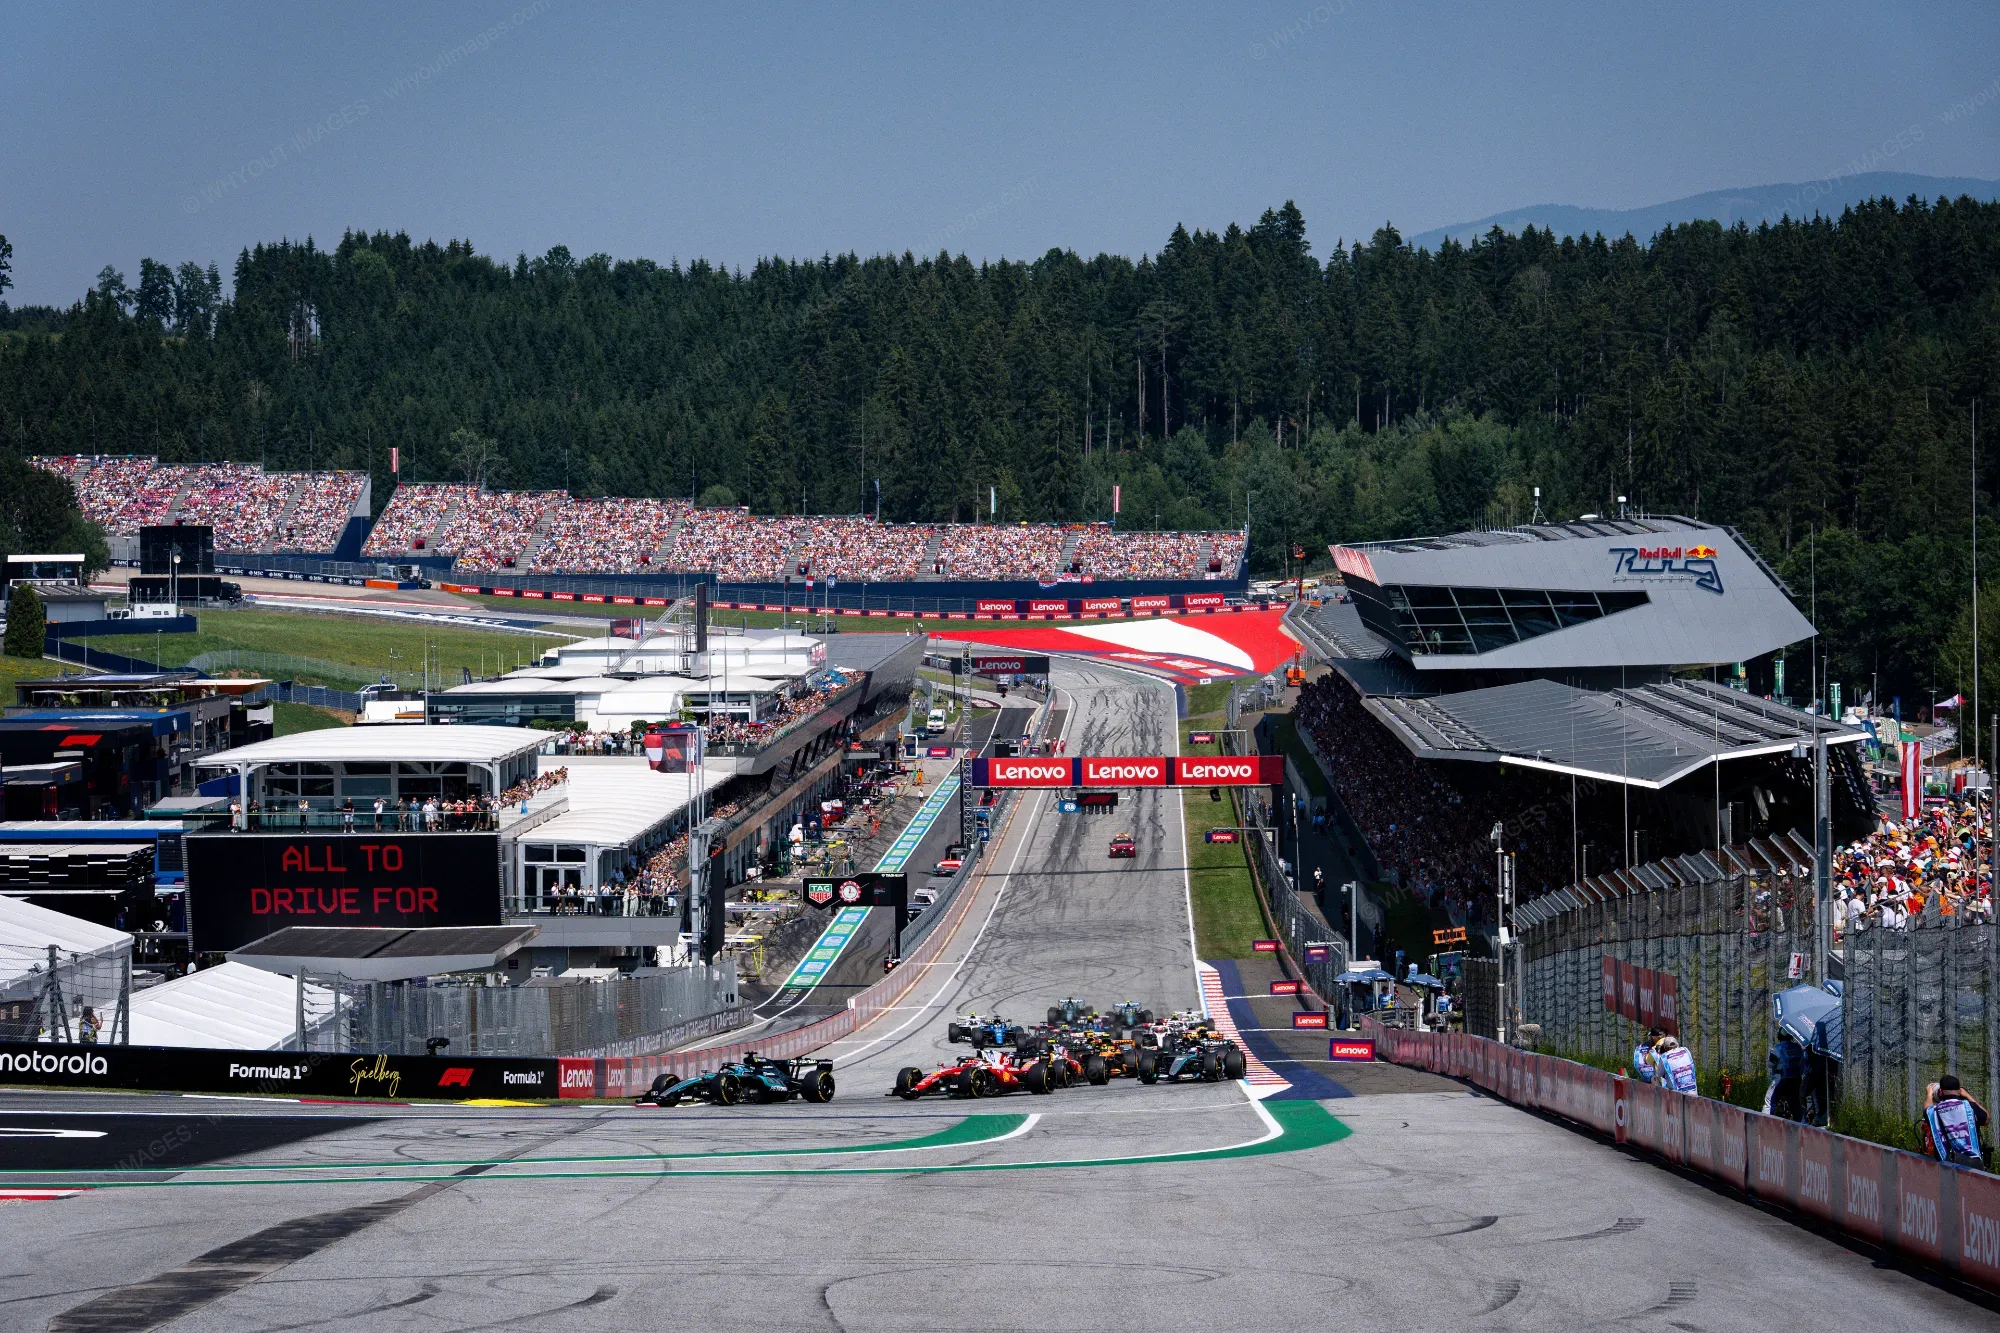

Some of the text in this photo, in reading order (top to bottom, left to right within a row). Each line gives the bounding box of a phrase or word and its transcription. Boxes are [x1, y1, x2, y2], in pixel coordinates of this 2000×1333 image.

[1639, 547, 1682, 559] Red Bull
[979, 602, 1013, 611] Lenovo
[1032, 602, 1065, 611] Lenovo
[1085, 601, 1118, 610] Lenovo
[1133, 599, 1167, 608] Lenovo
[1187, 597, 1221, 605] Lenovo
[979, 660, 1021, 670] Lenovo
[995, 764, 1066, 780] Lenovo
[1088, 764, 1159, 779] Lenovo
[1182, 763, 1253, 779] Lenovo
[282, 845, 403, 872] ALL TO
[251, 887, 439, 914] DRIVE FOR
[1335, 1046, 1369, 1055] Lenovo
[229, 1063, 291, 1080] Formula
[349, 1054, 402, 1097] Spielberg
[503, 1070, 536, 1084] Formula
[560, 1064, 593, 1088] Lenovo
[1758, 1134, 1785, 1188] Lenovo
[1801, 1148, 1830, 1205] Lenovo
[1846, 1161, 1880, 1223] Lenovo
[1900, 1176, 1939, 1246] Lenovo
